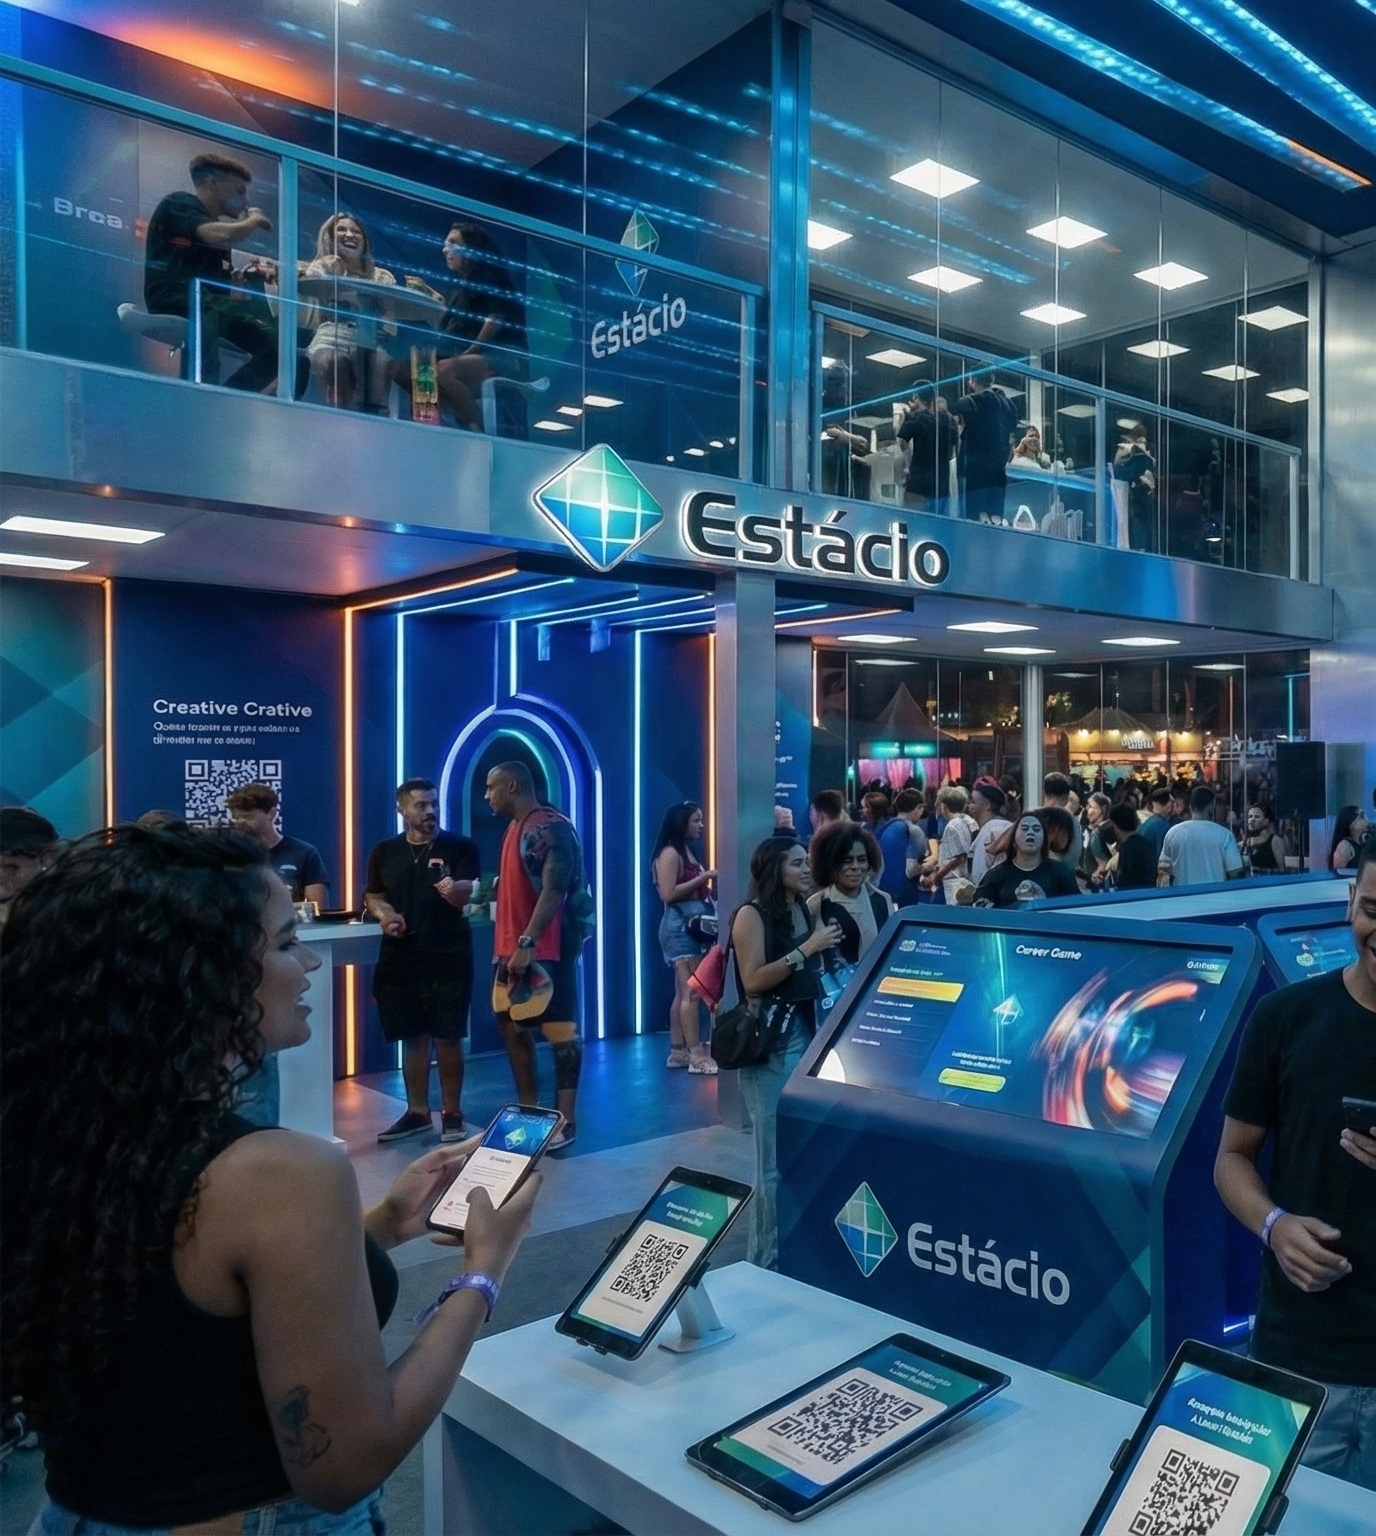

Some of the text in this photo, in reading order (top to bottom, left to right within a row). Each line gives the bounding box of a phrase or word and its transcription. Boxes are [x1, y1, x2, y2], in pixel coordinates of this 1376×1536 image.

[591, 293, 686, 358] Estácio
[681, 490, 951, 587] Estácio
[153, 699, 313, 718] Creative Crative
[907, 1222, 1070, 1306] Estácio
